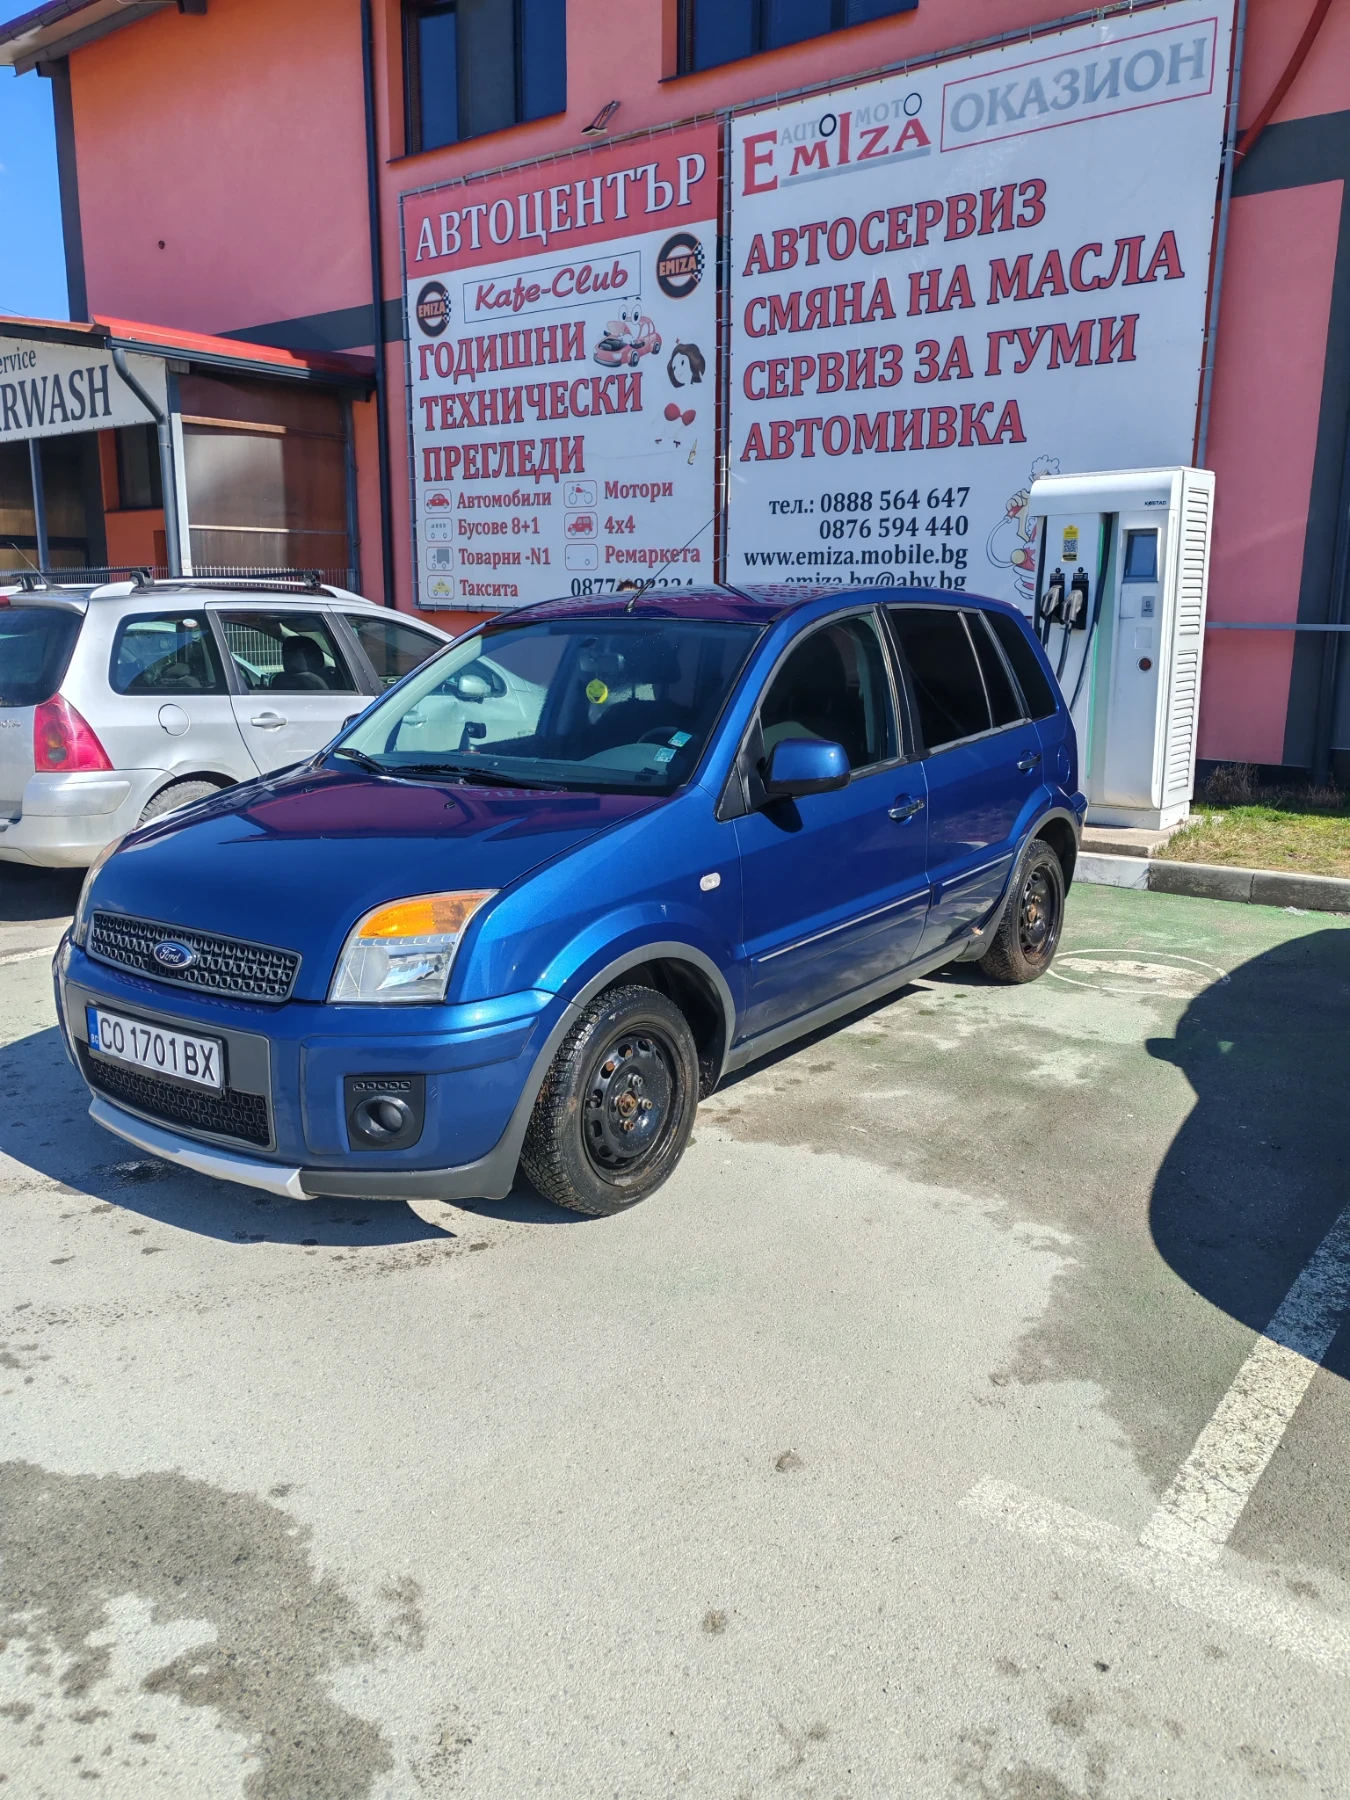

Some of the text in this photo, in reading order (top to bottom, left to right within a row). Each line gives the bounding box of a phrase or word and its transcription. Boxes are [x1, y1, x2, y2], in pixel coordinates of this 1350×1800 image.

[949, 37, 1208, 134] ОКАЗИОН
[414, 152, 707, 262] АВТОЦЕНТЪР
[743, 178, 1047, 277] АВТОСЕРВИЗ
[658, 254, 697, 276] EMIZA
[475, 260, 628, 312] Kafe-Club
[744, 230, 1185, 338] СМЯНА НА МАСЛА
[418, 302, 446, 318] EMIZA
[418, 321, 587, 385] ГОДИШНИ
[743, 314, 1140, 400] СЕРВИЗ ЗА ГУМИ
[419, 372, 643, 431] ТЕХНИЧЕСКИ
[740, 400, 1027, 462] АВТОМИВКА
[422, 435, 586, 484] ПРЕГЛЕДИ
[456, 489, 552, 509] Автомобили
[604, 480, 674, 503] Мотори
[769, 486, 970, 514] тел.: 0888 564 647
[458, 516, 540, 540] Бусове 8+1
[604, 514, 635, 534] 4x4
[819, 515, 969, 539] 0876 594 440
[458, 547, 551, 570] Товарни -N1
[604, 545, 701, 568] Ремаркета
[743, 543, 969, 569] www.emiza.mobile.bg
[459, 579, 519, 597] Таксита
[159, 946, 181, 963] Ford
[100, 1017, 215, 1081] CO 1701 BX
